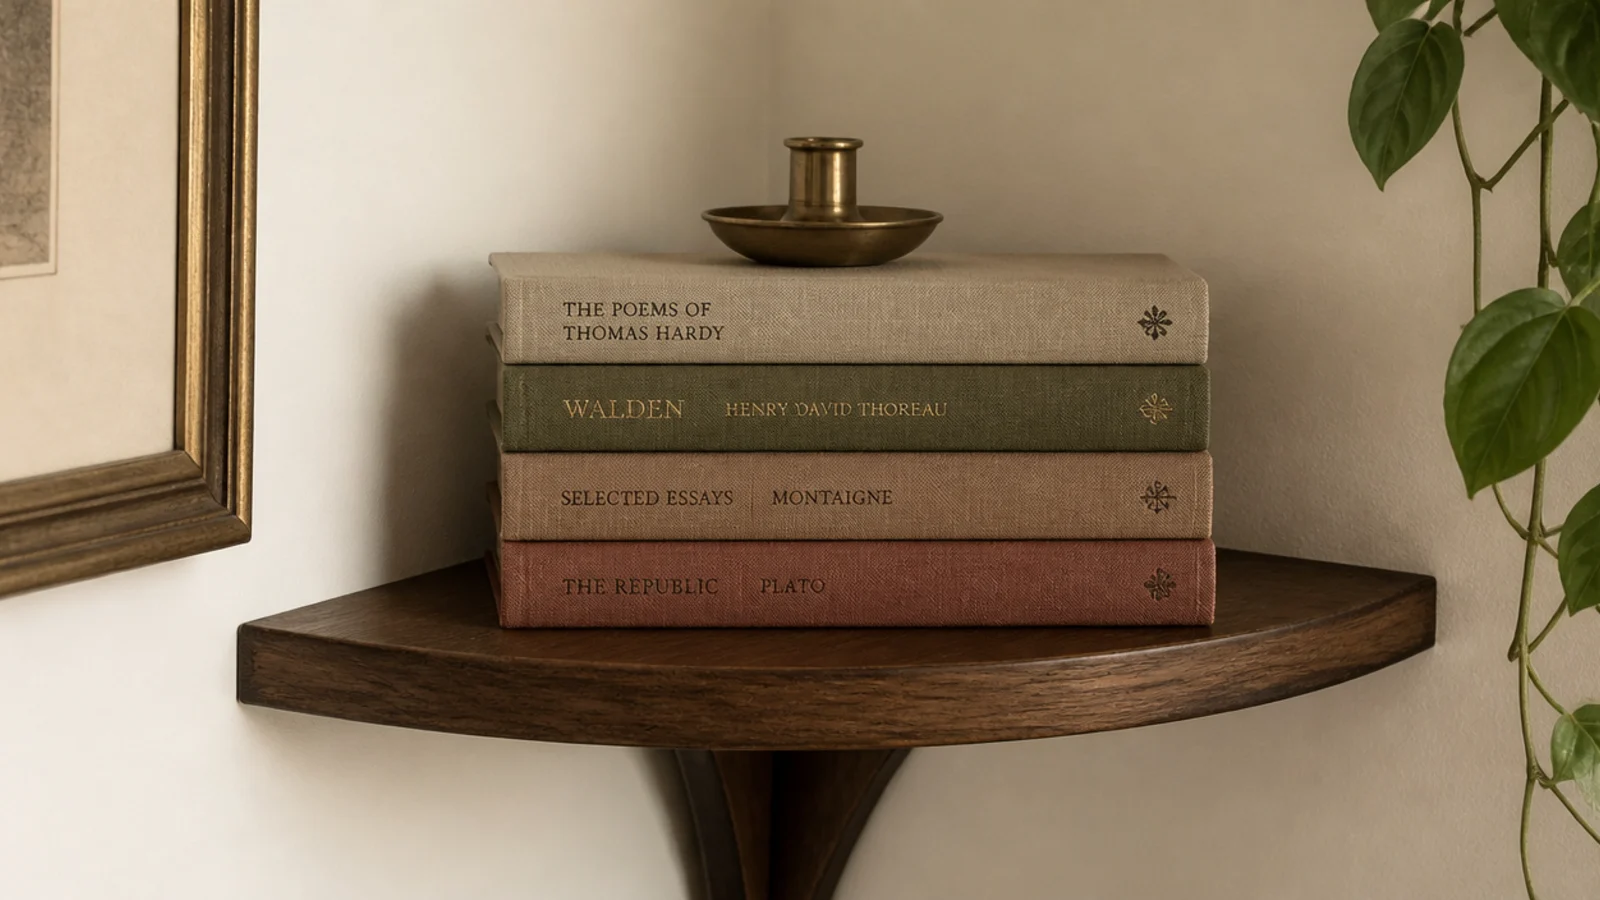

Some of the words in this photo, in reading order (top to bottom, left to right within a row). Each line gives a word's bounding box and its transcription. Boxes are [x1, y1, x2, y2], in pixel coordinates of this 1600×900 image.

[563, 302, 605, 317] THE
[612, 302, 678, 317] POEMS
[685, 302, 711, 317] OF
[563, 325, 648, 341] THOMAS
[656, 325, 724, 341] HARDY
[563, 399, 684, 419] WALDEN
[725, 402, 788, 417] HENRY
[795, 402, 852, 417] DAVID
[857, 402, 948, 417] THOREAU
[561, 490, 659, 506] SELECTED
[667, 490, 733, 506] ESSAYS
[772, 490, 893, 506] MONTAIGNE
[563, 578, 605, 595] THE
[614, 578, 719, 595] REPUBLIC
[760, 578, 826, 594] PLATO
